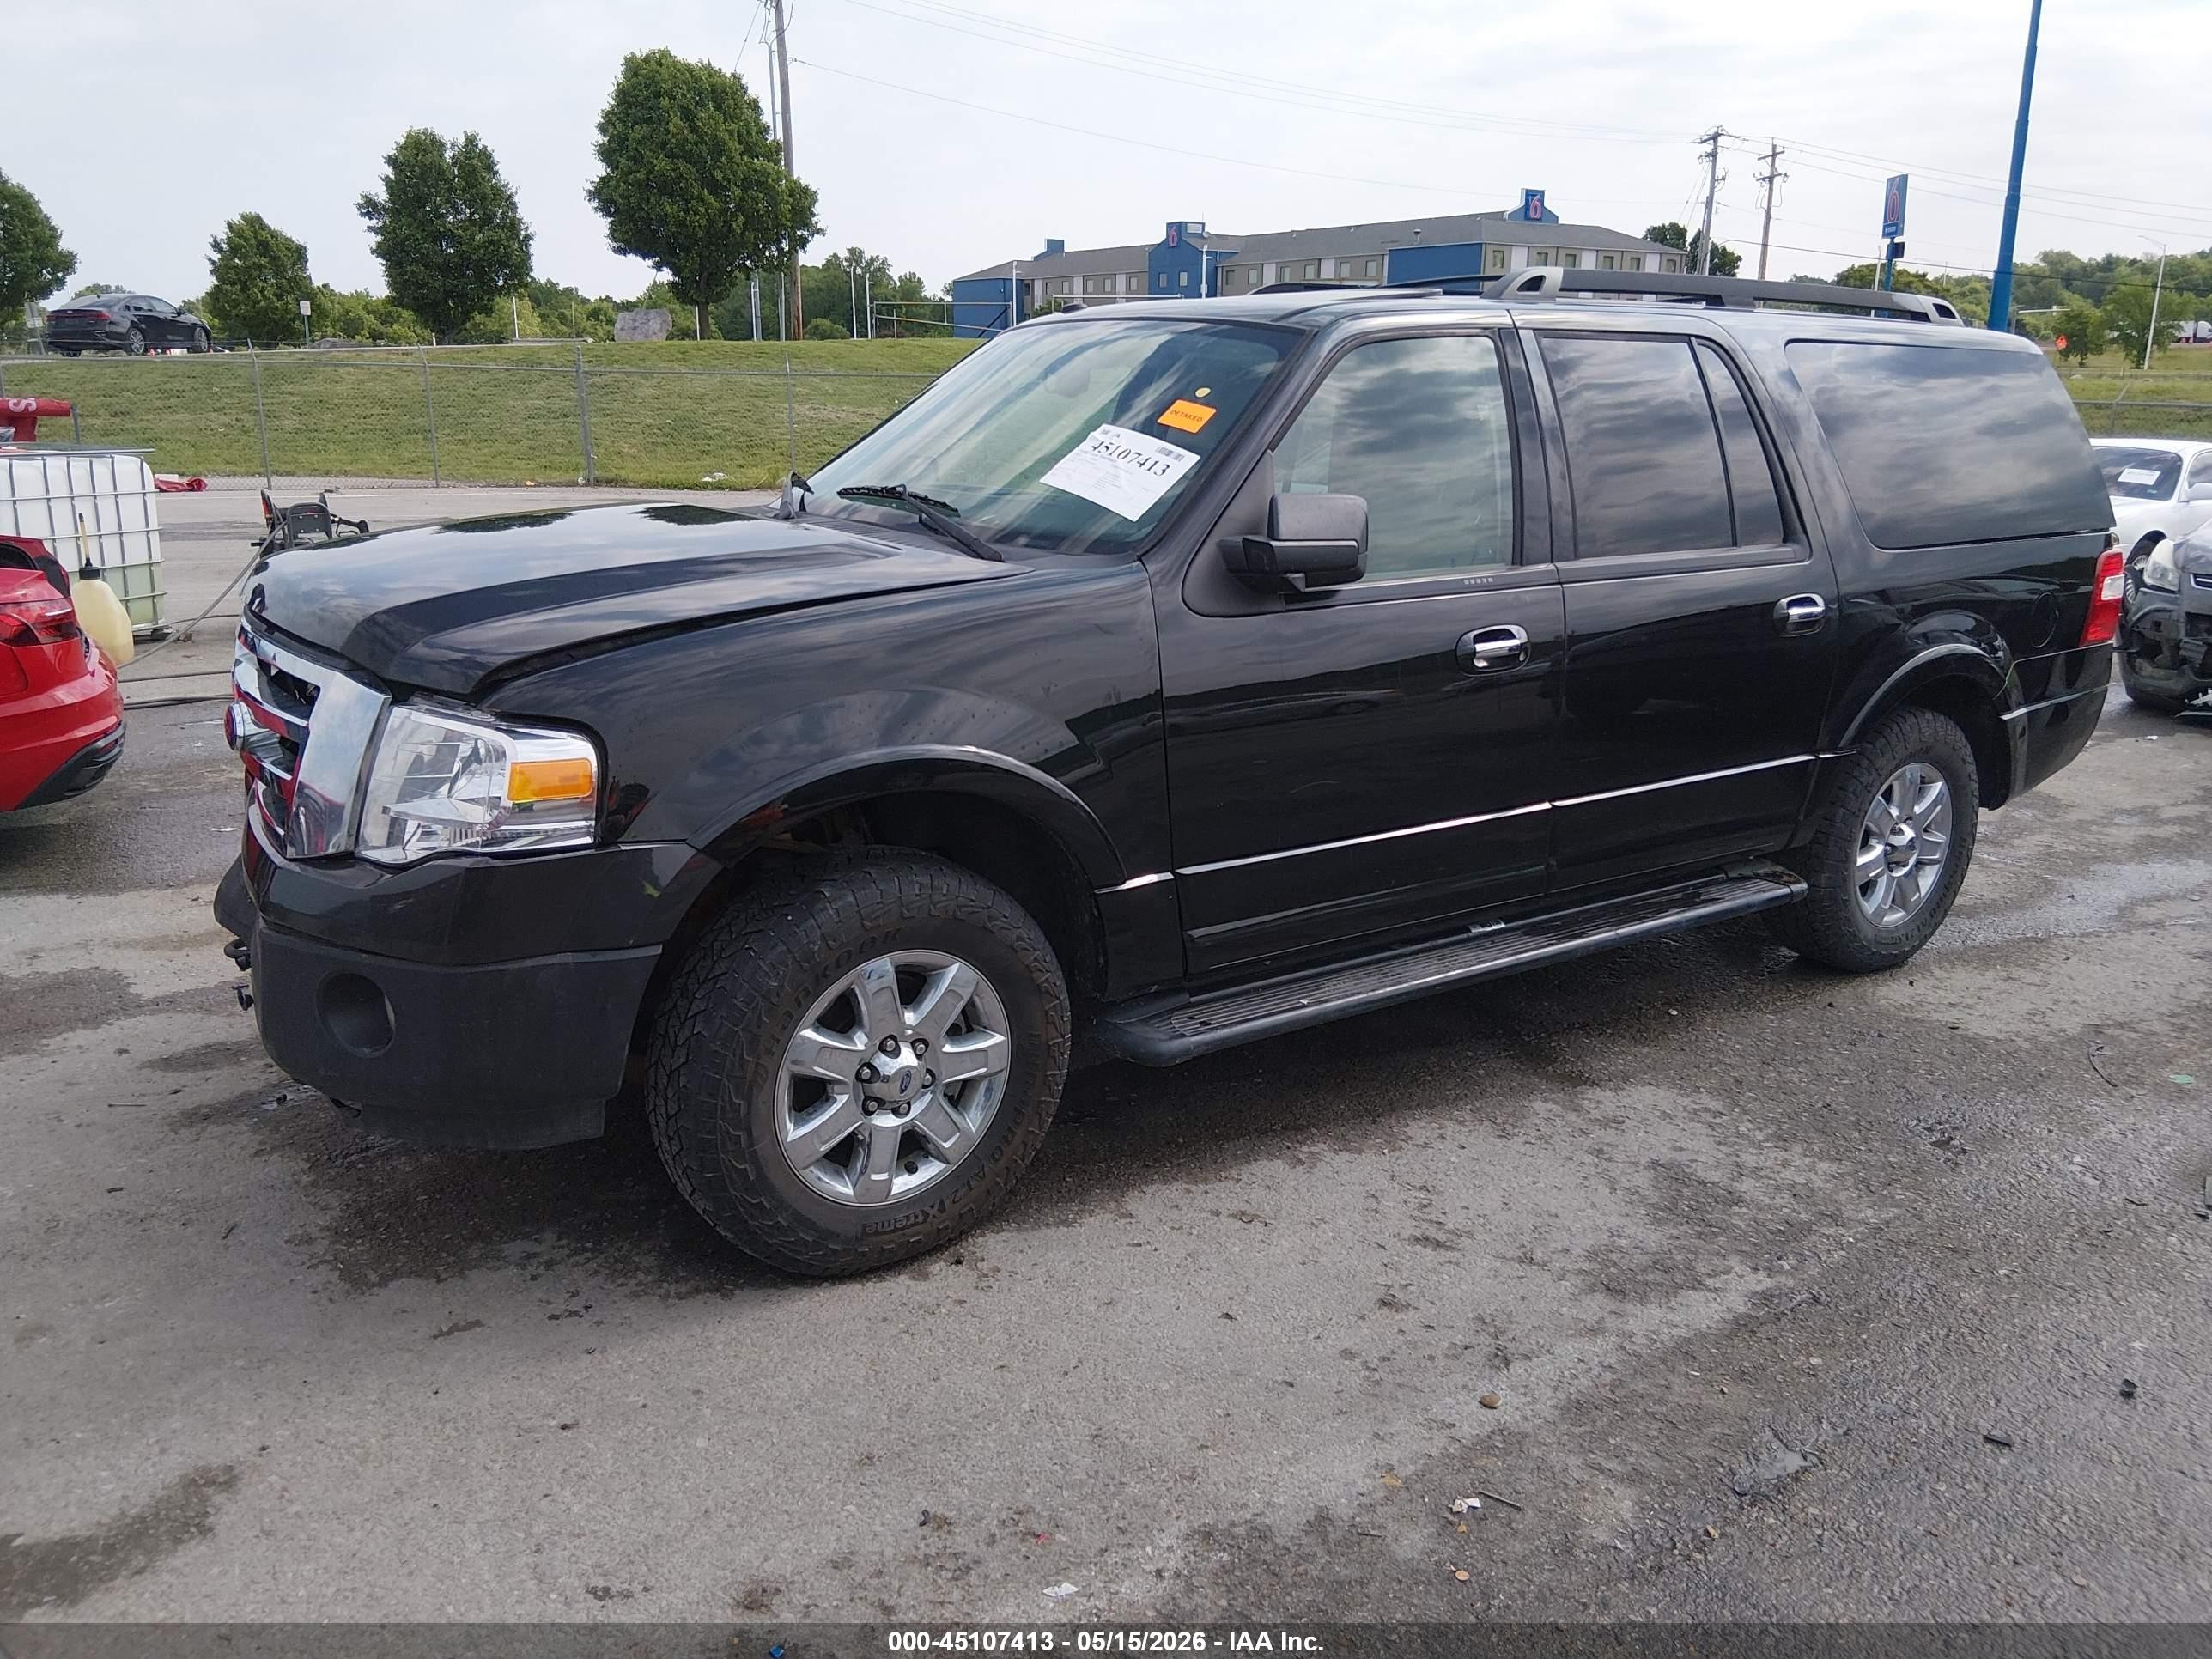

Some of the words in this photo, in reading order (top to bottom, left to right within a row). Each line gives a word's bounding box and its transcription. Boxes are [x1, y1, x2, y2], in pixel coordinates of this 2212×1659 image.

[1530, 193, 1541, 220] 6
[1887, 177, 1899, 223] 6
[1169, 226, 1178, 247] 6
[1170, 410, 1203, 422] DETAILED
[1091, 441, 1170, 477] 45107413
[865, 1200, 945, 1234] Xtreme
